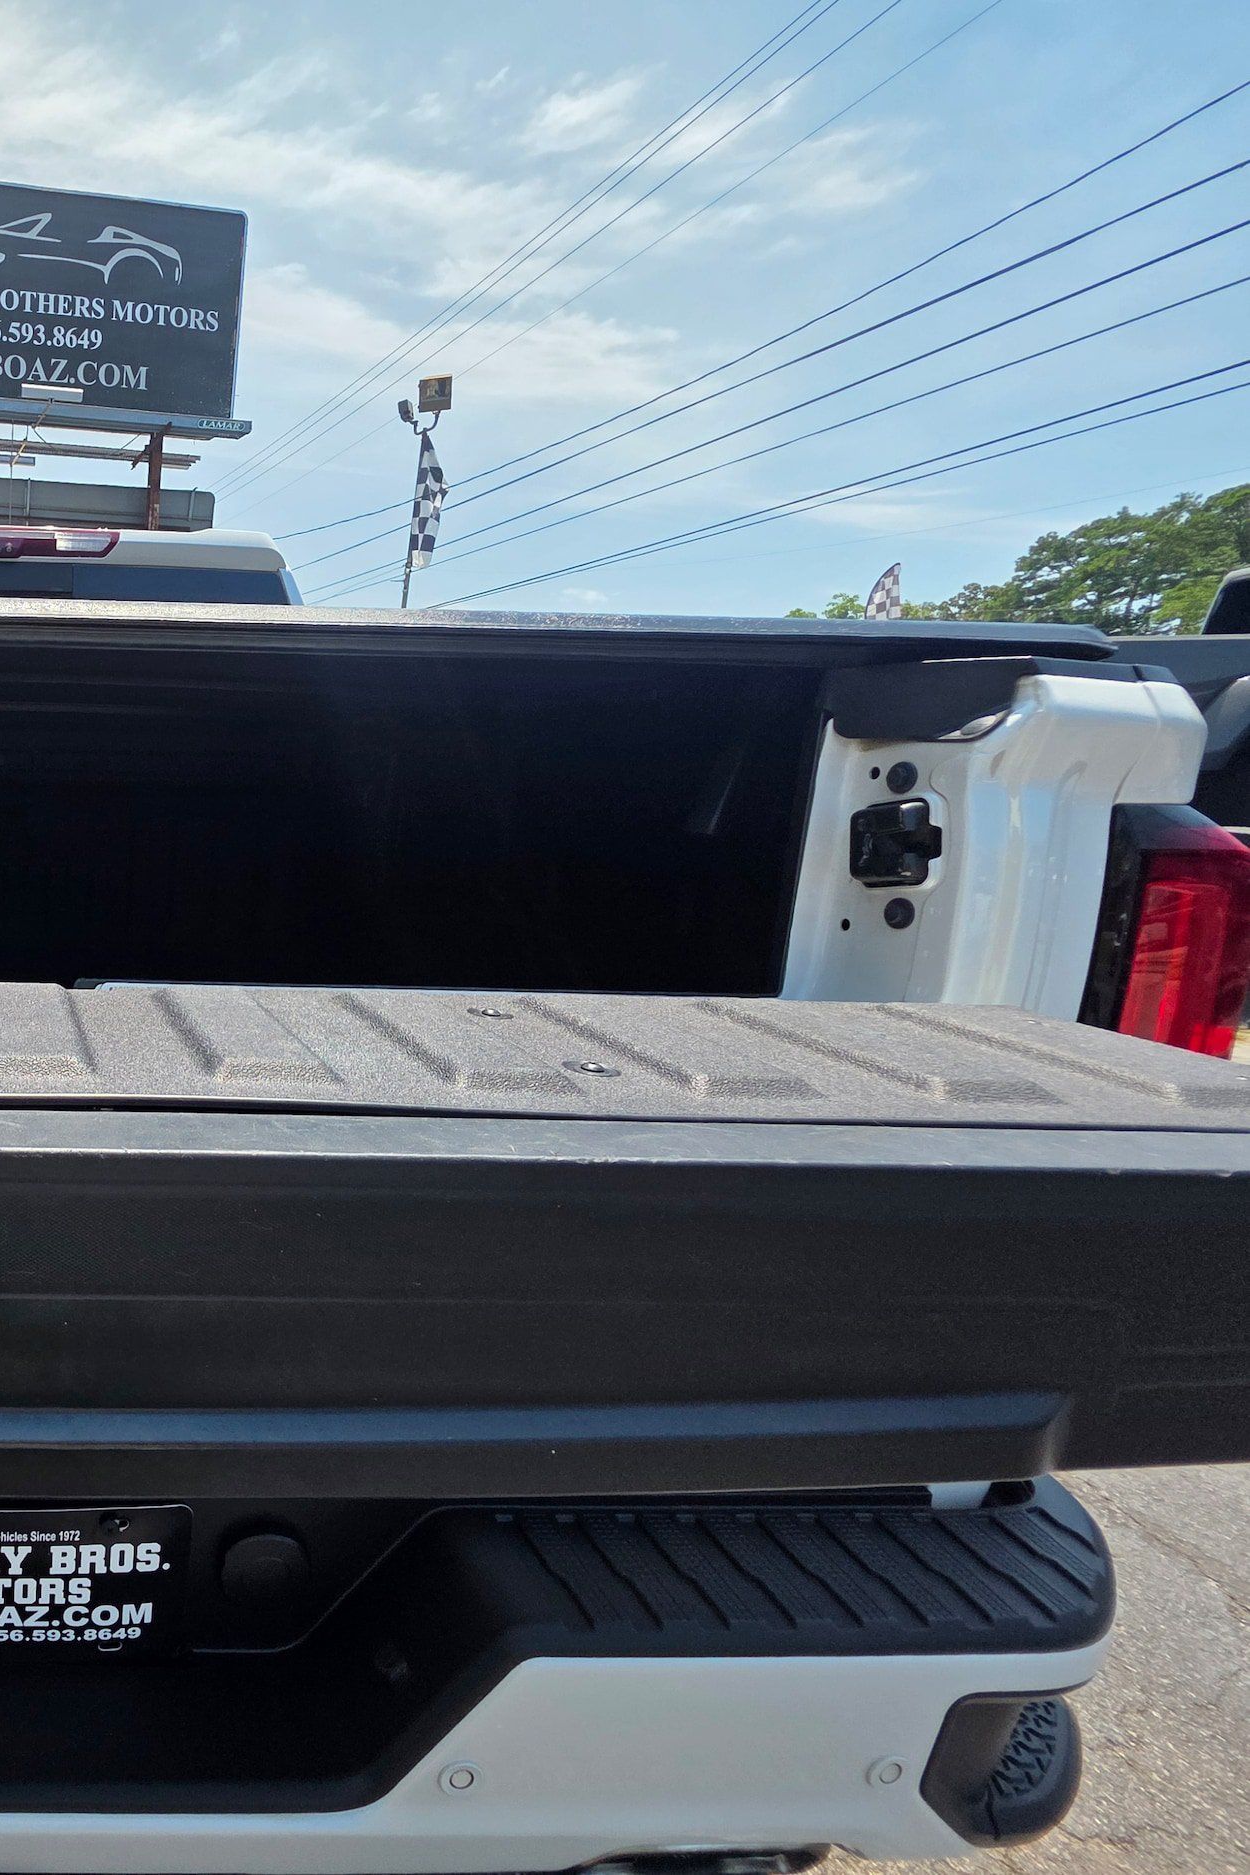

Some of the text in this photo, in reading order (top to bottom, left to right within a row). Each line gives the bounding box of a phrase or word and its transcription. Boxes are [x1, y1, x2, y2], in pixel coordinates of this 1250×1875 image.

[111, 300, 219, 332] MOTORS
[203, 420, 241, 431] LAMAR
[30, 1530, 56, 1542] Since
[58, 1530, 80, 1542] 1972
[49, 1542, 171, 1575] BROS.
